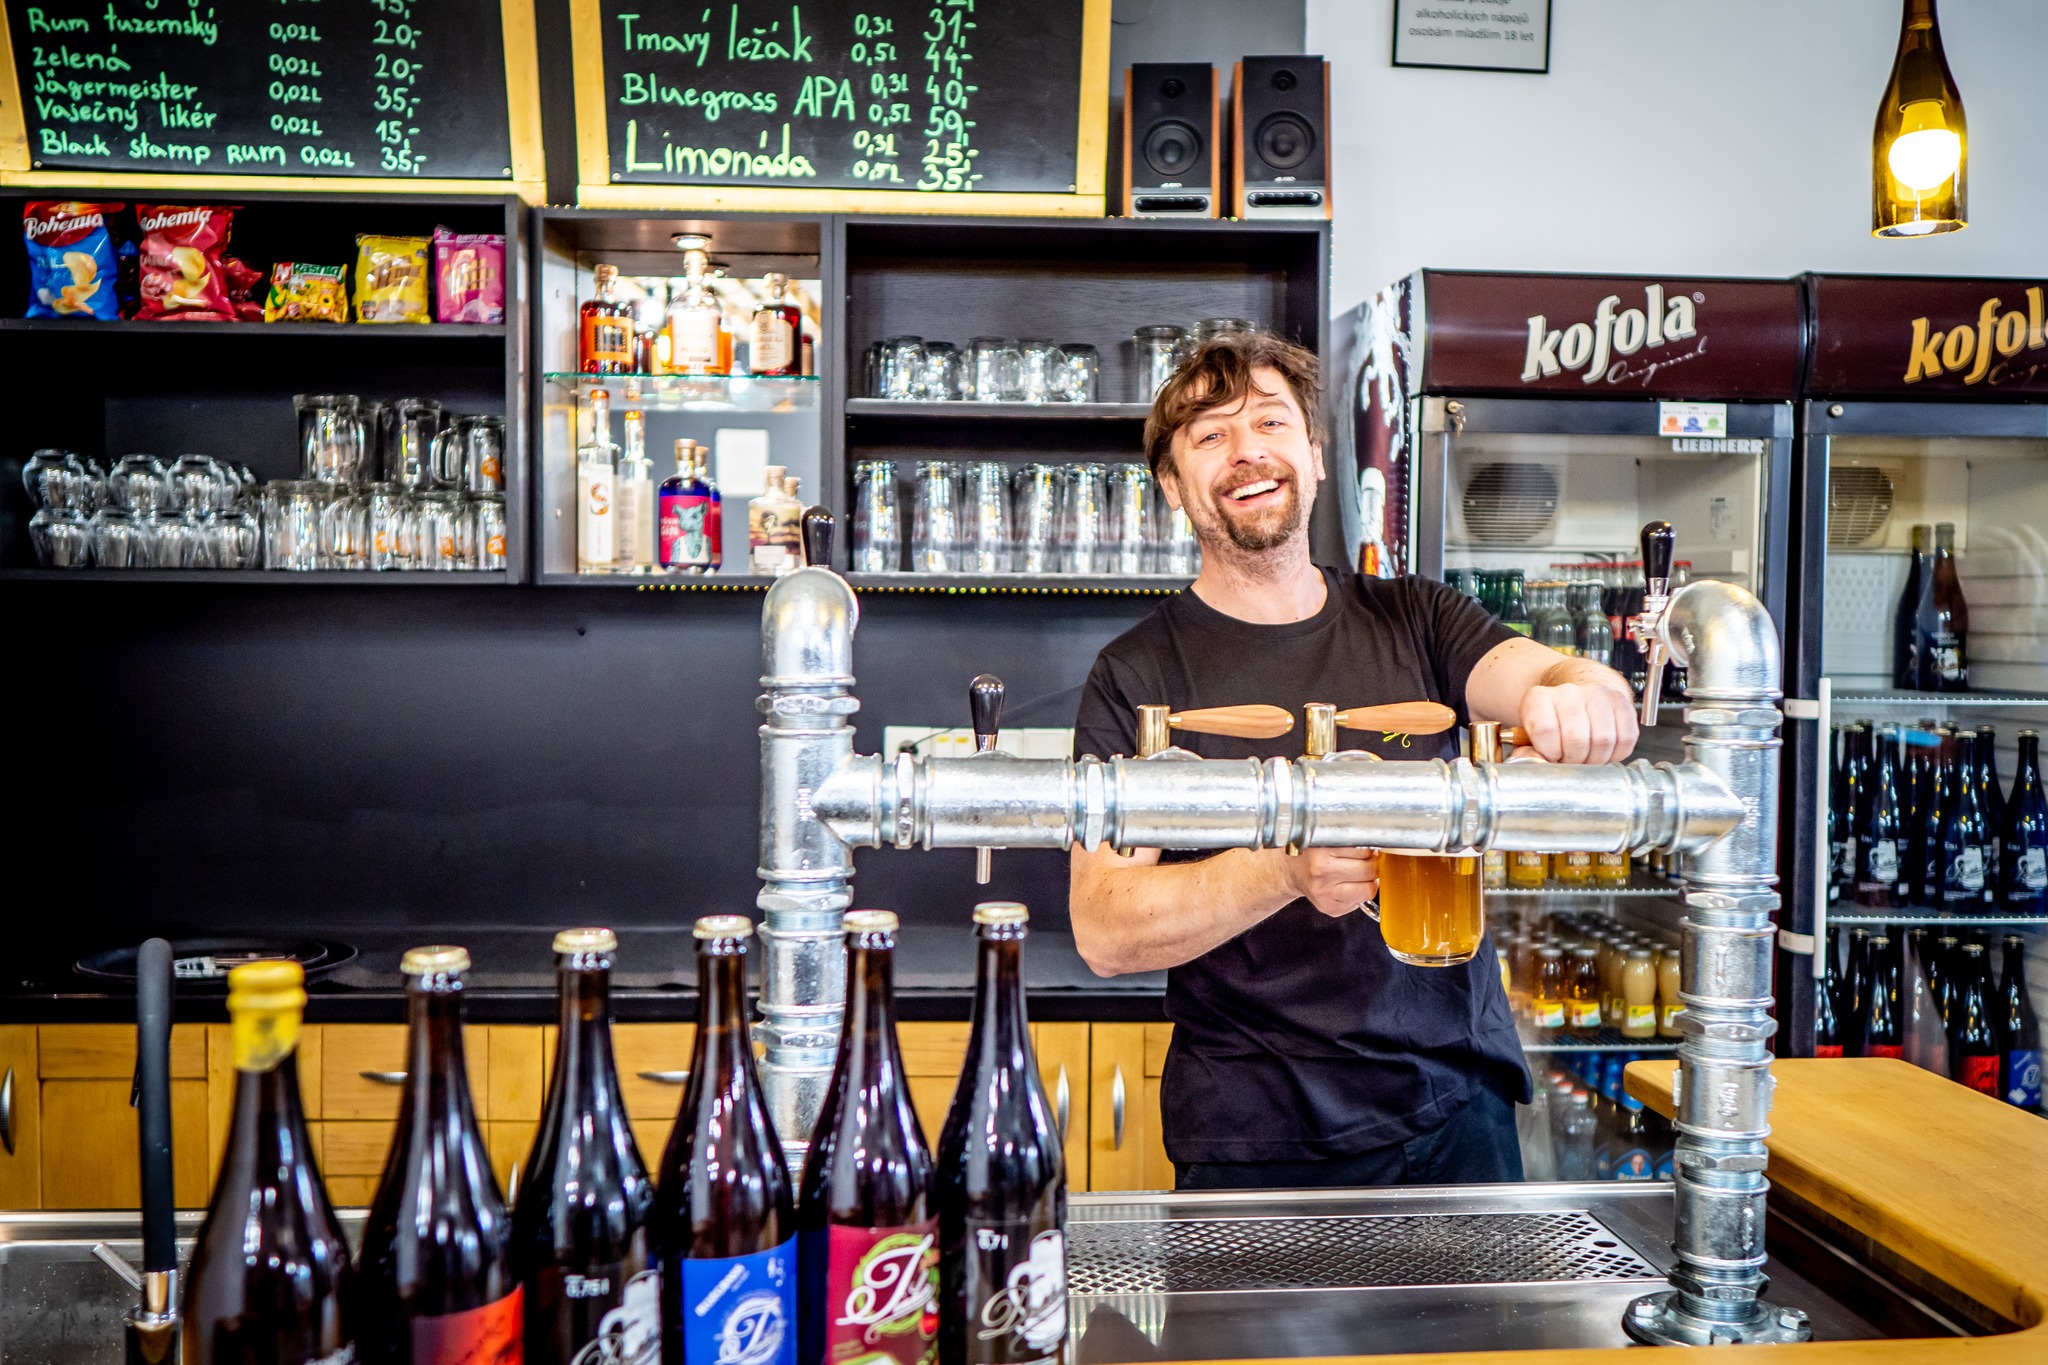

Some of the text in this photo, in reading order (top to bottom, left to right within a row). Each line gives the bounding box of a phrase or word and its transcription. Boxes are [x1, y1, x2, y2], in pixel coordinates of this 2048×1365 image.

[27, 7, 90, 34] Rum
[103, 2, 219, 46] tuzemský
[1415, 9, 1529, 25] alkoholických nápojů
[617, 8, 711, 67] Tmavý
[728, 3, 813, 62] ležák
[1408, 26, 1535, 42] osobám mladším 18 let
[32, 43, 132, 72] Zelená
[34, 69, 199, 101] Jägermeister
[620, 72, 778, 122] Bluegrass
[793, 75, 856, 121] APA
[160, 101, 218, 130] likér
[39, 128, 111, 157] Black
[625, 119, 817, 178] Limonáda
[23, 213, 104, 240] Bohemia
[1521, 283, 1697, 385] kofola
[1903, 287, 2048, 386] kofol
[1672, 438, 1764, 453] LIEBHERR
